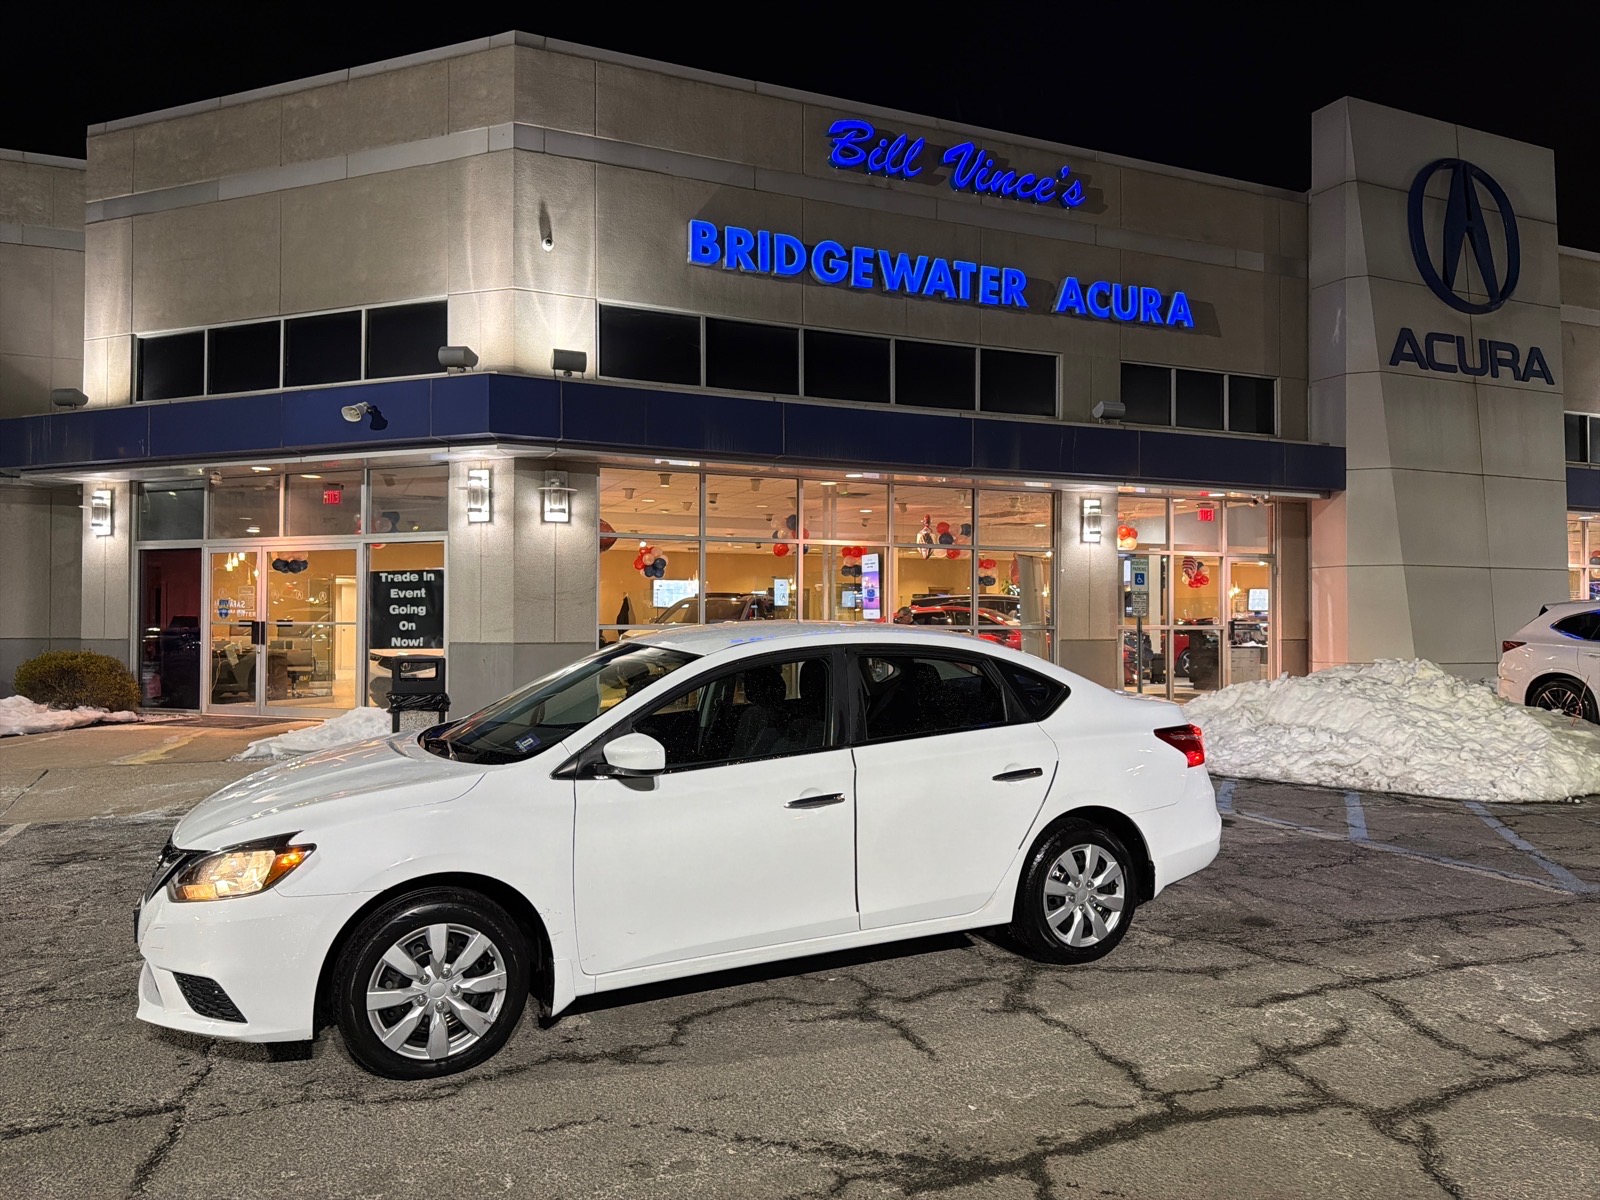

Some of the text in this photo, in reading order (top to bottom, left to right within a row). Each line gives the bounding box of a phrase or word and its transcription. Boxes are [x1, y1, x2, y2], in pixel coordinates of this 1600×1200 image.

[827, 119, 1086, 208] Bill Vince's
[687, 218, 1195, 328] BRIDGEWATER ACURA
[1388, 327, 1555, 385] ACURA
[379, 571, 435, 582] Trade In
[390, 588, 426, 598] Event
[389, 604, 426, 616] Going
[399, 620, 416, 631] On
[391, 637, 424, 647] Now!
